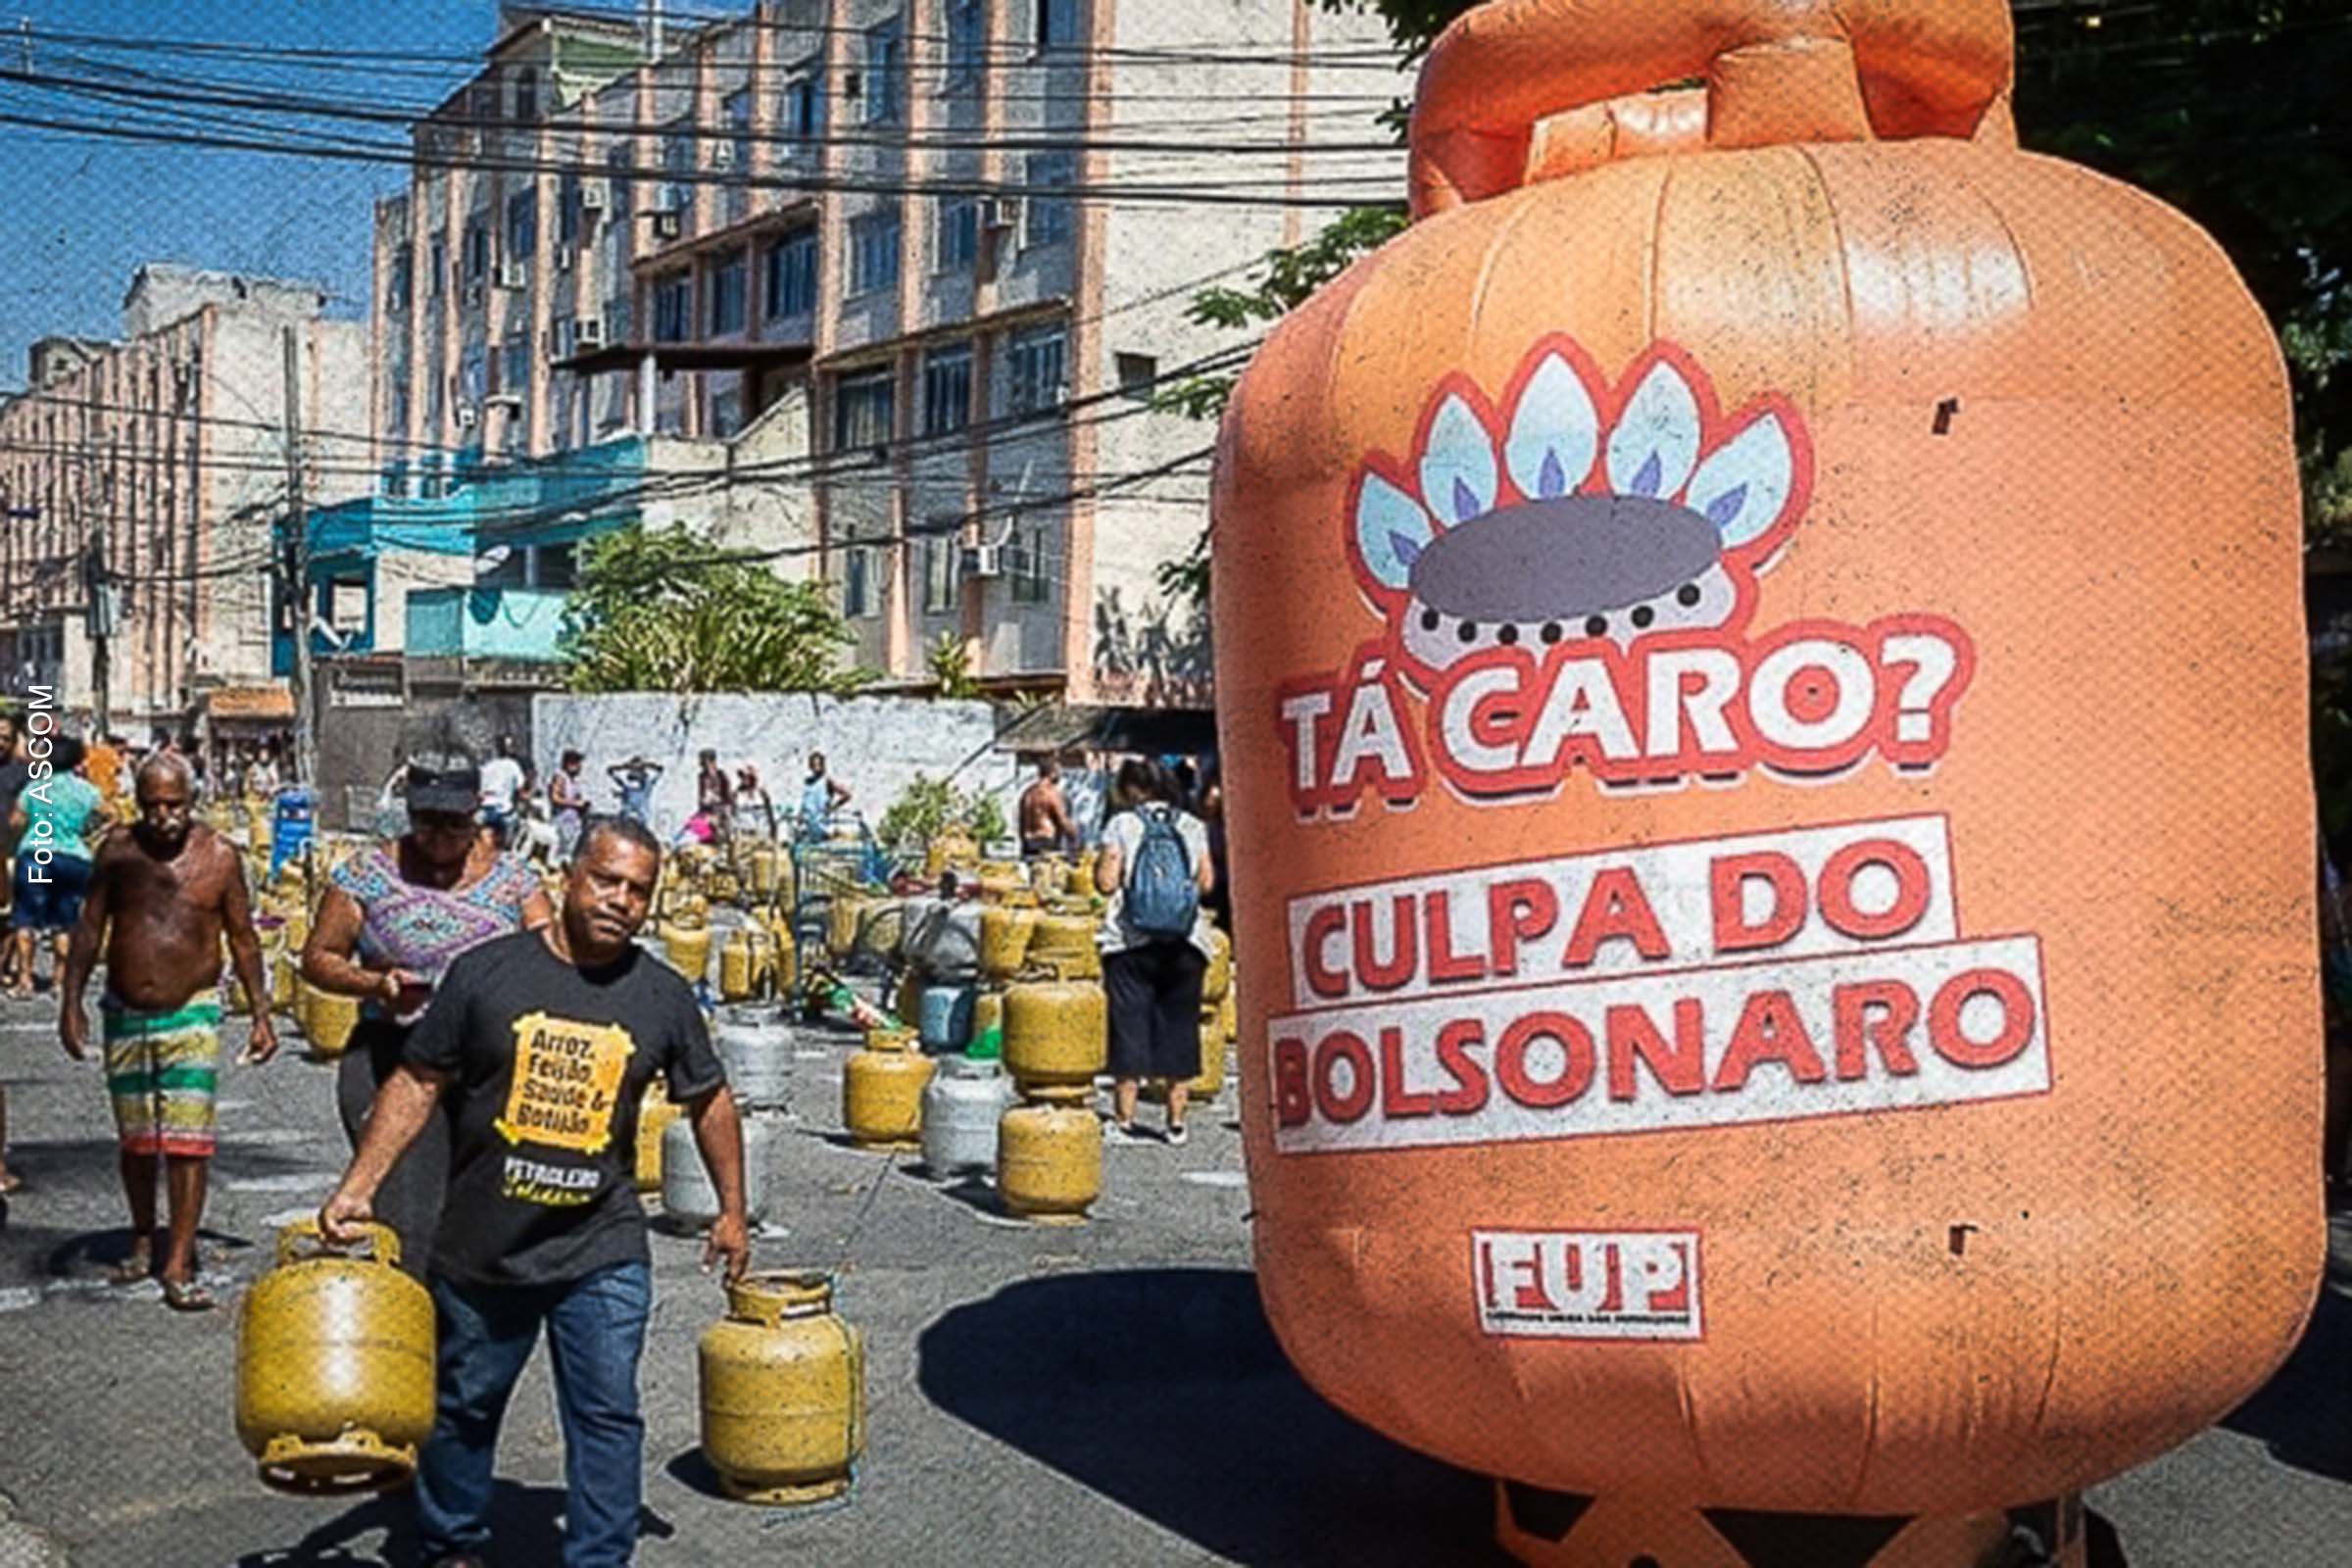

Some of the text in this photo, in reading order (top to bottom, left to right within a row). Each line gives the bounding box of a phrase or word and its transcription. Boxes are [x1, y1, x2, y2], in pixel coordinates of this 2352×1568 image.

[1282, 633, 1958, 789] TÁ CARO?
[1301, 839, 1933, 998] CULPA DO
[591, 1090, 612, 1112] &
[1274, 968, 2035, 1127] BOLSONARO
[1488, 1239, 1686, 1312] FUP
